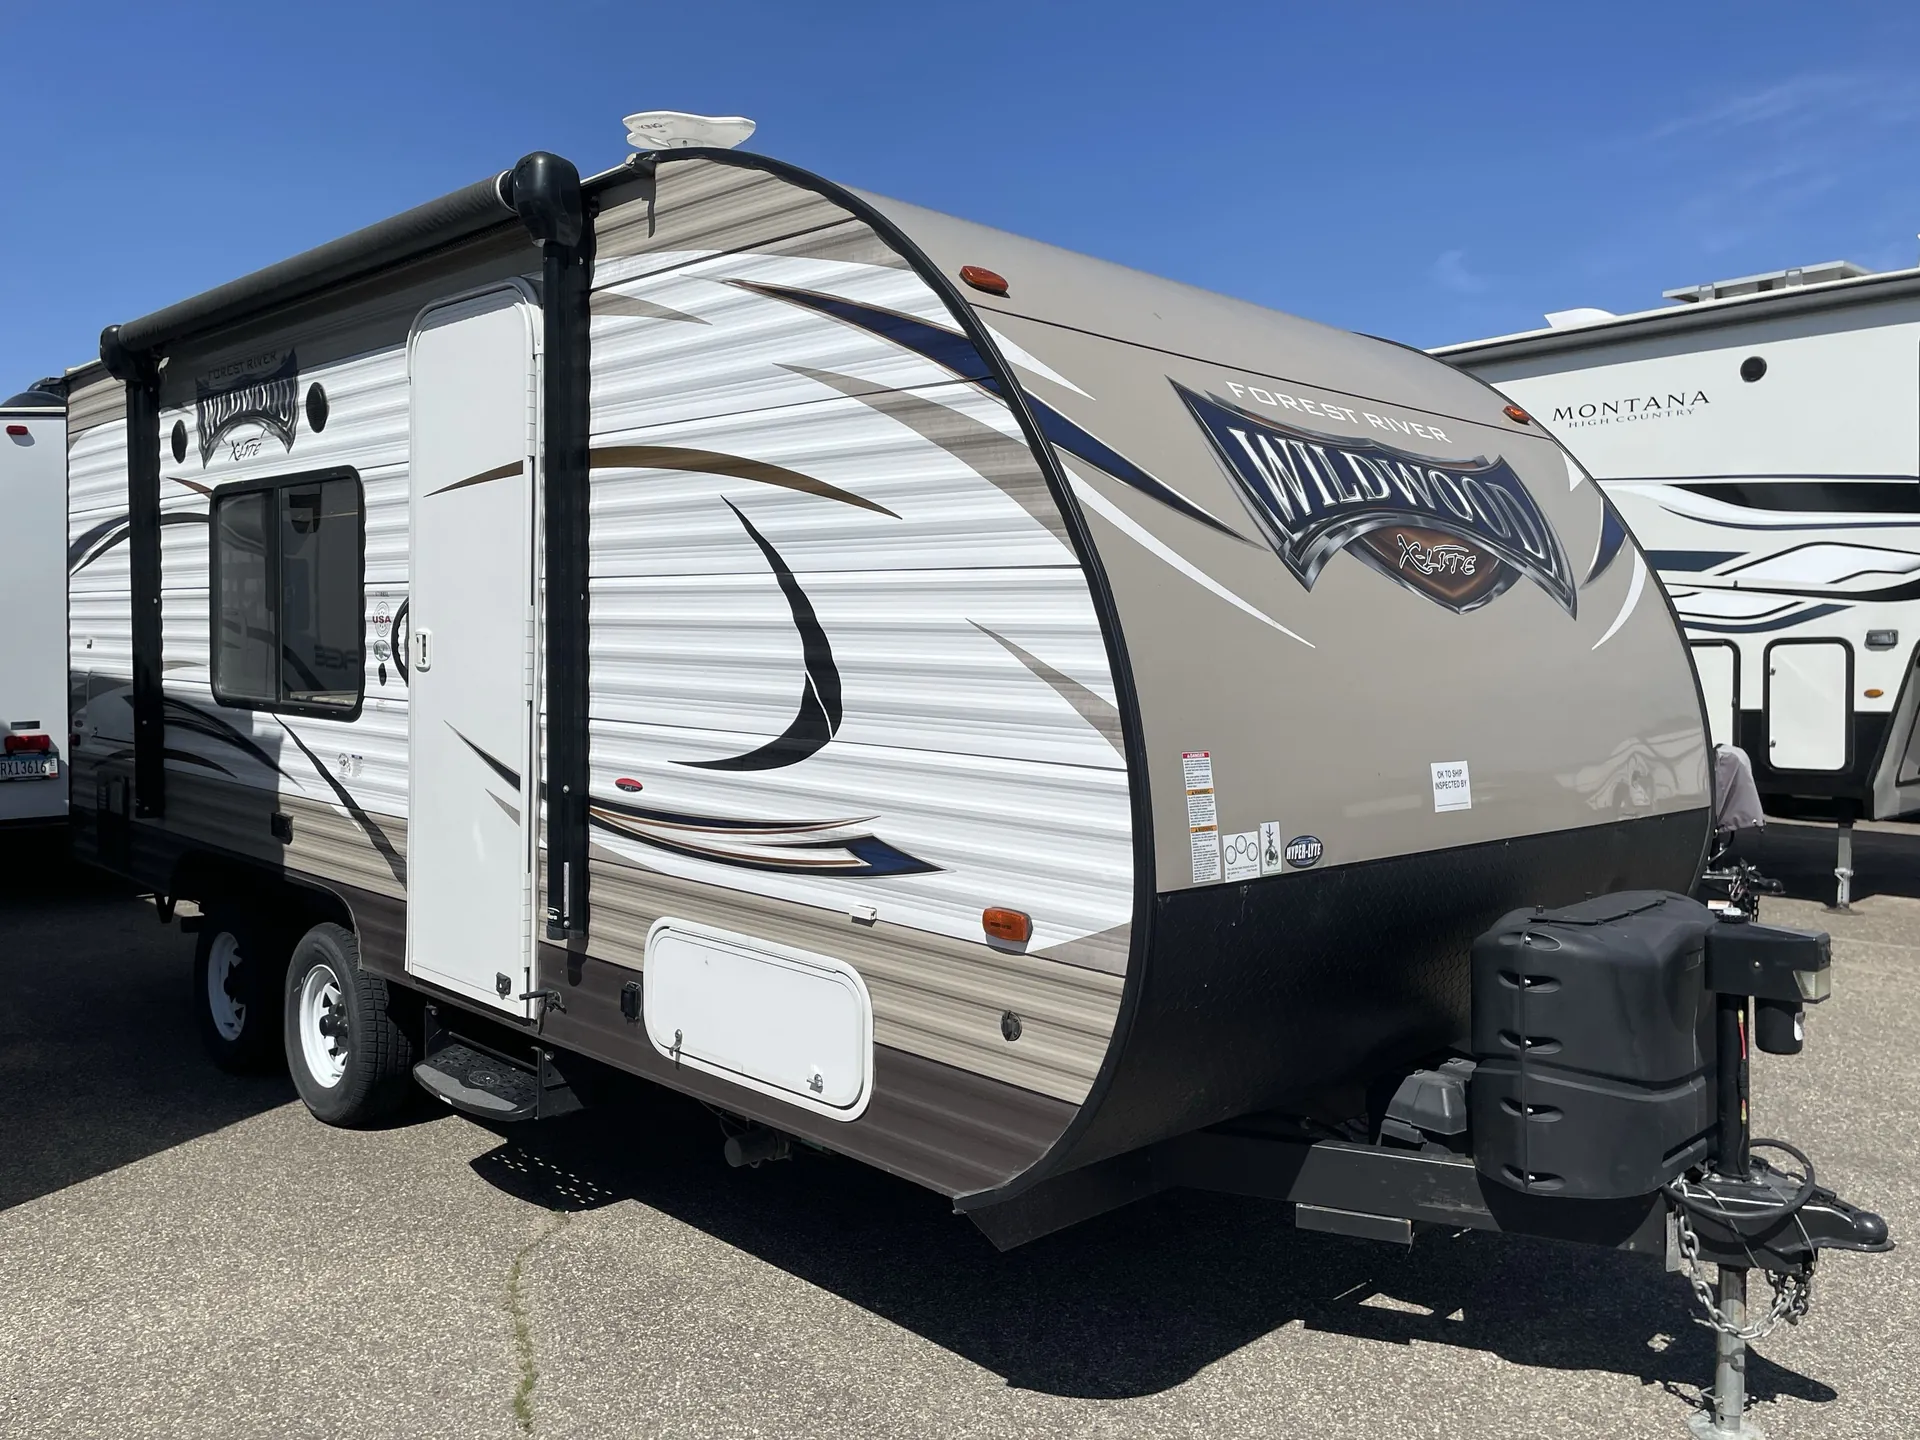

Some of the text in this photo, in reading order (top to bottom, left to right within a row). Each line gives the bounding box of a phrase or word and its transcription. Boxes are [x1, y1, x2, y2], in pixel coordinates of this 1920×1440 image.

[208, 350, 277, 380] FOREST RIVER
[1226, 380, 1453, 444] FOREST RIVER
[1552, 390, 1710, 422] MONTANA
[1568, 408, 1696, 429] HIGH COUNTRY
[229, 438, 262, 461] X-LITE
[1227, 426, 1546, 560] WILDWOOD
[1396, 533, 1477, 576] X-LITE
[372, 615, 392, 624] USA
[0, 760, 47, 775] RX13616
[1437, 768, 1463, 779] OK TO SHIP
[1435, 779, 1467, 790] INSPECTED BY
[1286, 842, 1321, 860] HYPER-LYTE
